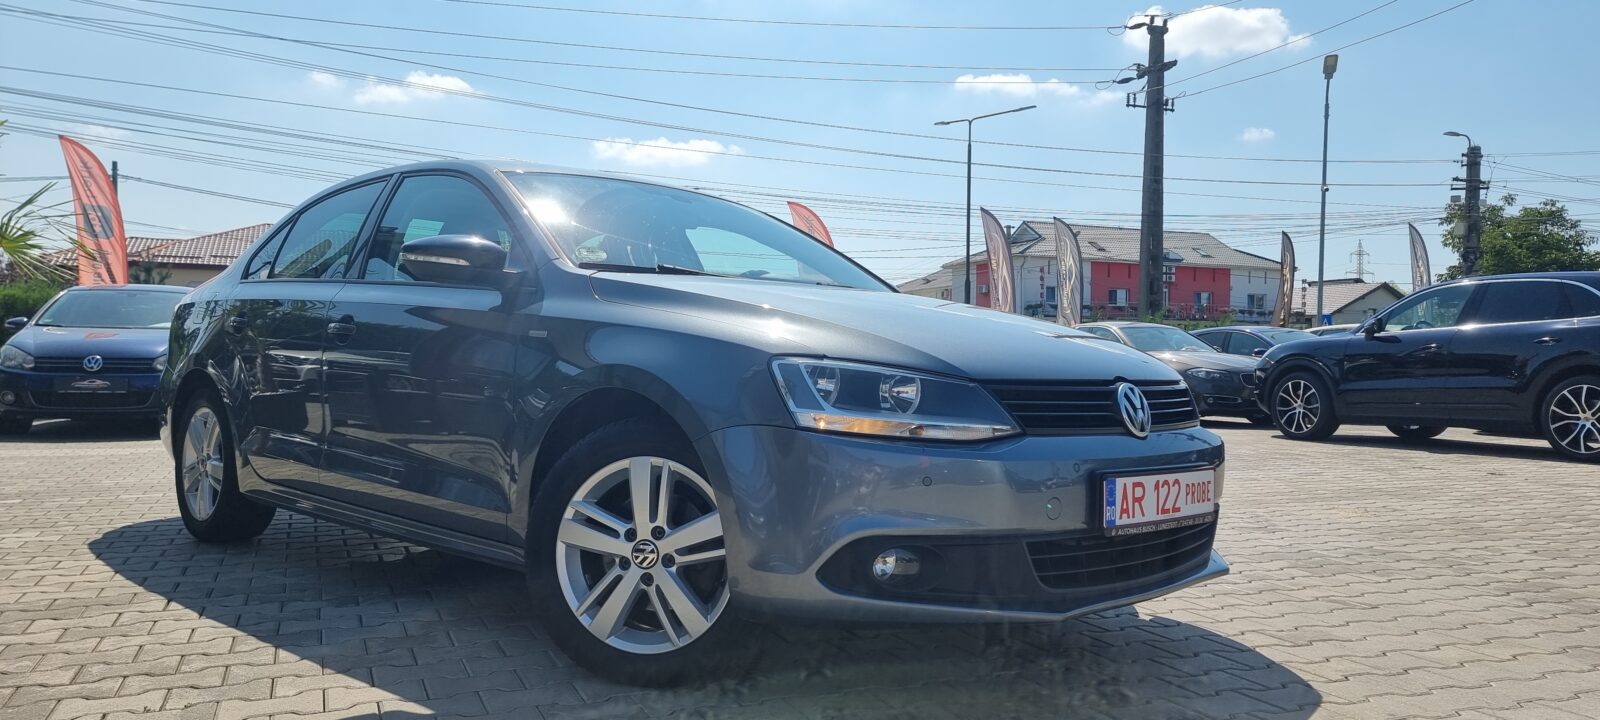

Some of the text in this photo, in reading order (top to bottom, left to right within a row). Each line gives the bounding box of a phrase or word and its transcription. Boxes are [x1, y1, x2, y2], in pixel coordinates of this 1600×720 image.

[1118, 382, 1151, 437] VW
[1119, 478, 1211, 520] AR 122 PROBE
[1106, 506, 1116, 521] RO
[1118, 525, 1142, 535] AUTOHAUS
